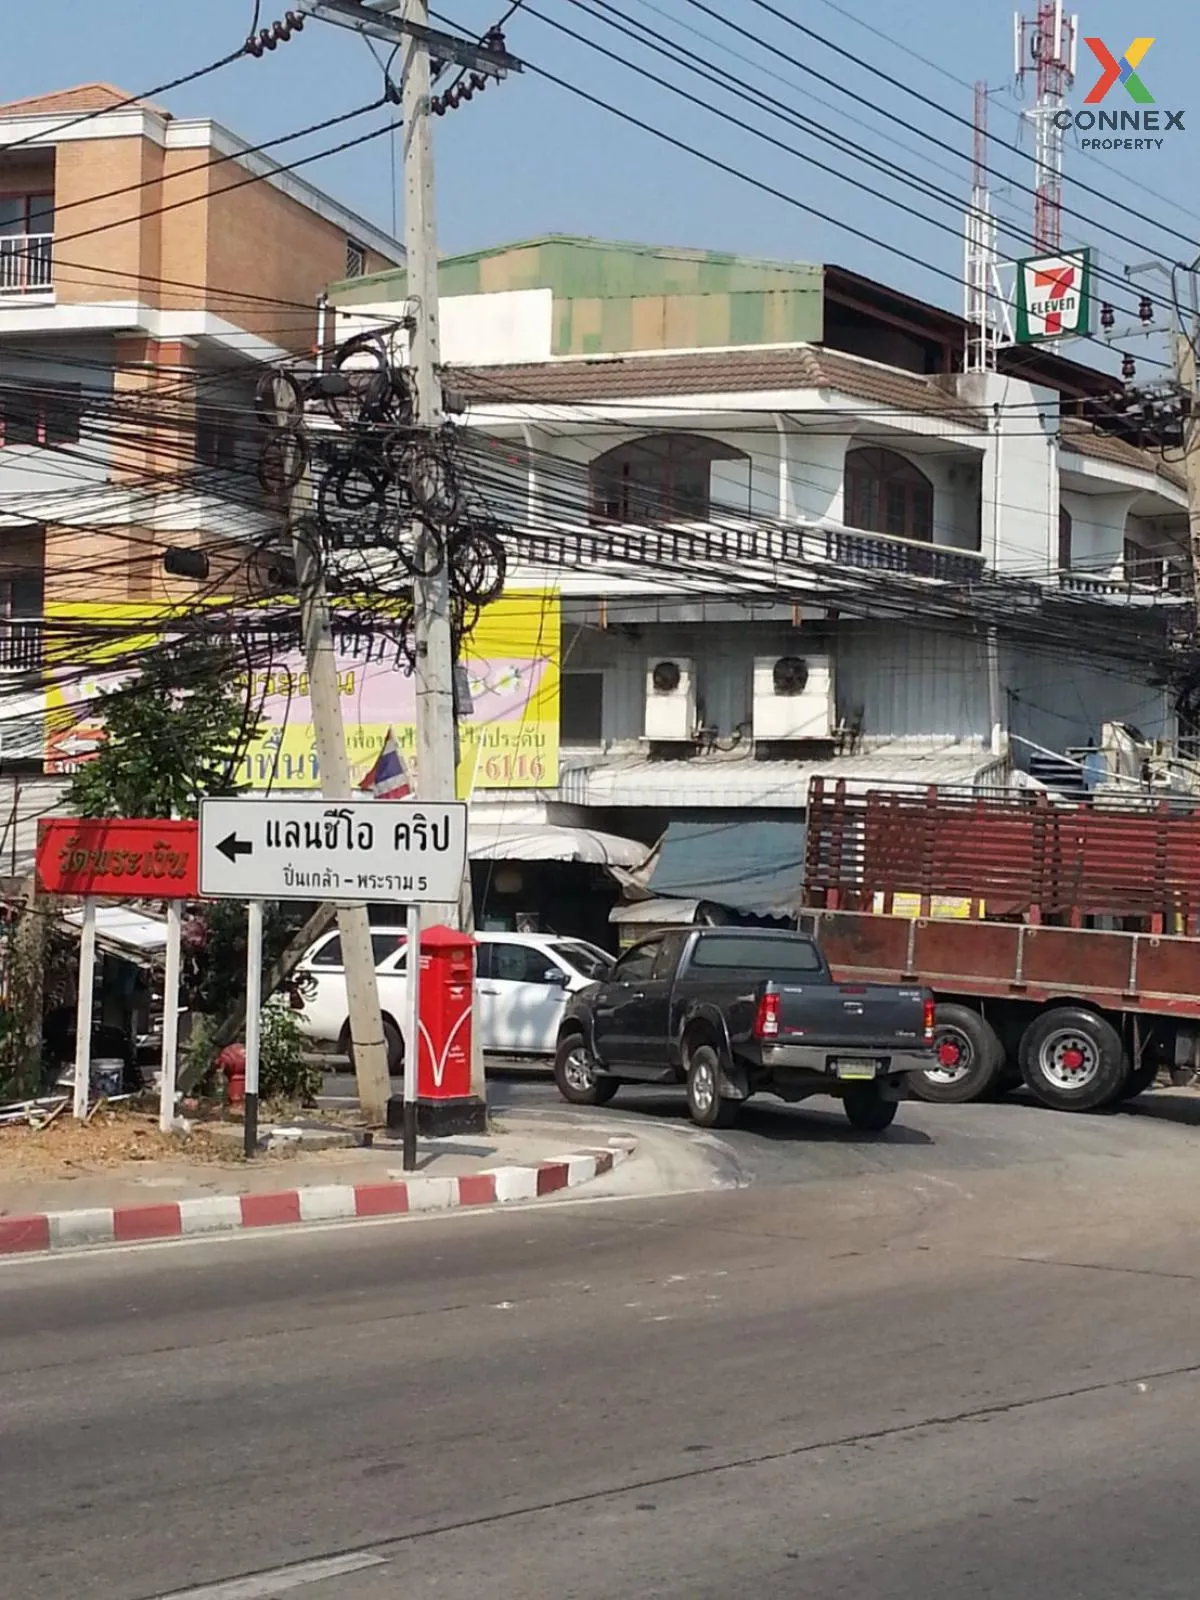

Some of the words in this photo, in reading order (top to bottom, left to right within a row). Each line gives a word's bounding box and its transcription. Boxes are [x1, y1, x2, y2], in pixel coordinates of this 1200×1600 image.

[1034, 266, 1075, 334] 7
[393, 812, 450, 852] คริป
[283, 863, 340, 888] ปิ่นเกล้า
[357, 874, 413, 891] พระราม
[418, 877, 428, 891] 5
